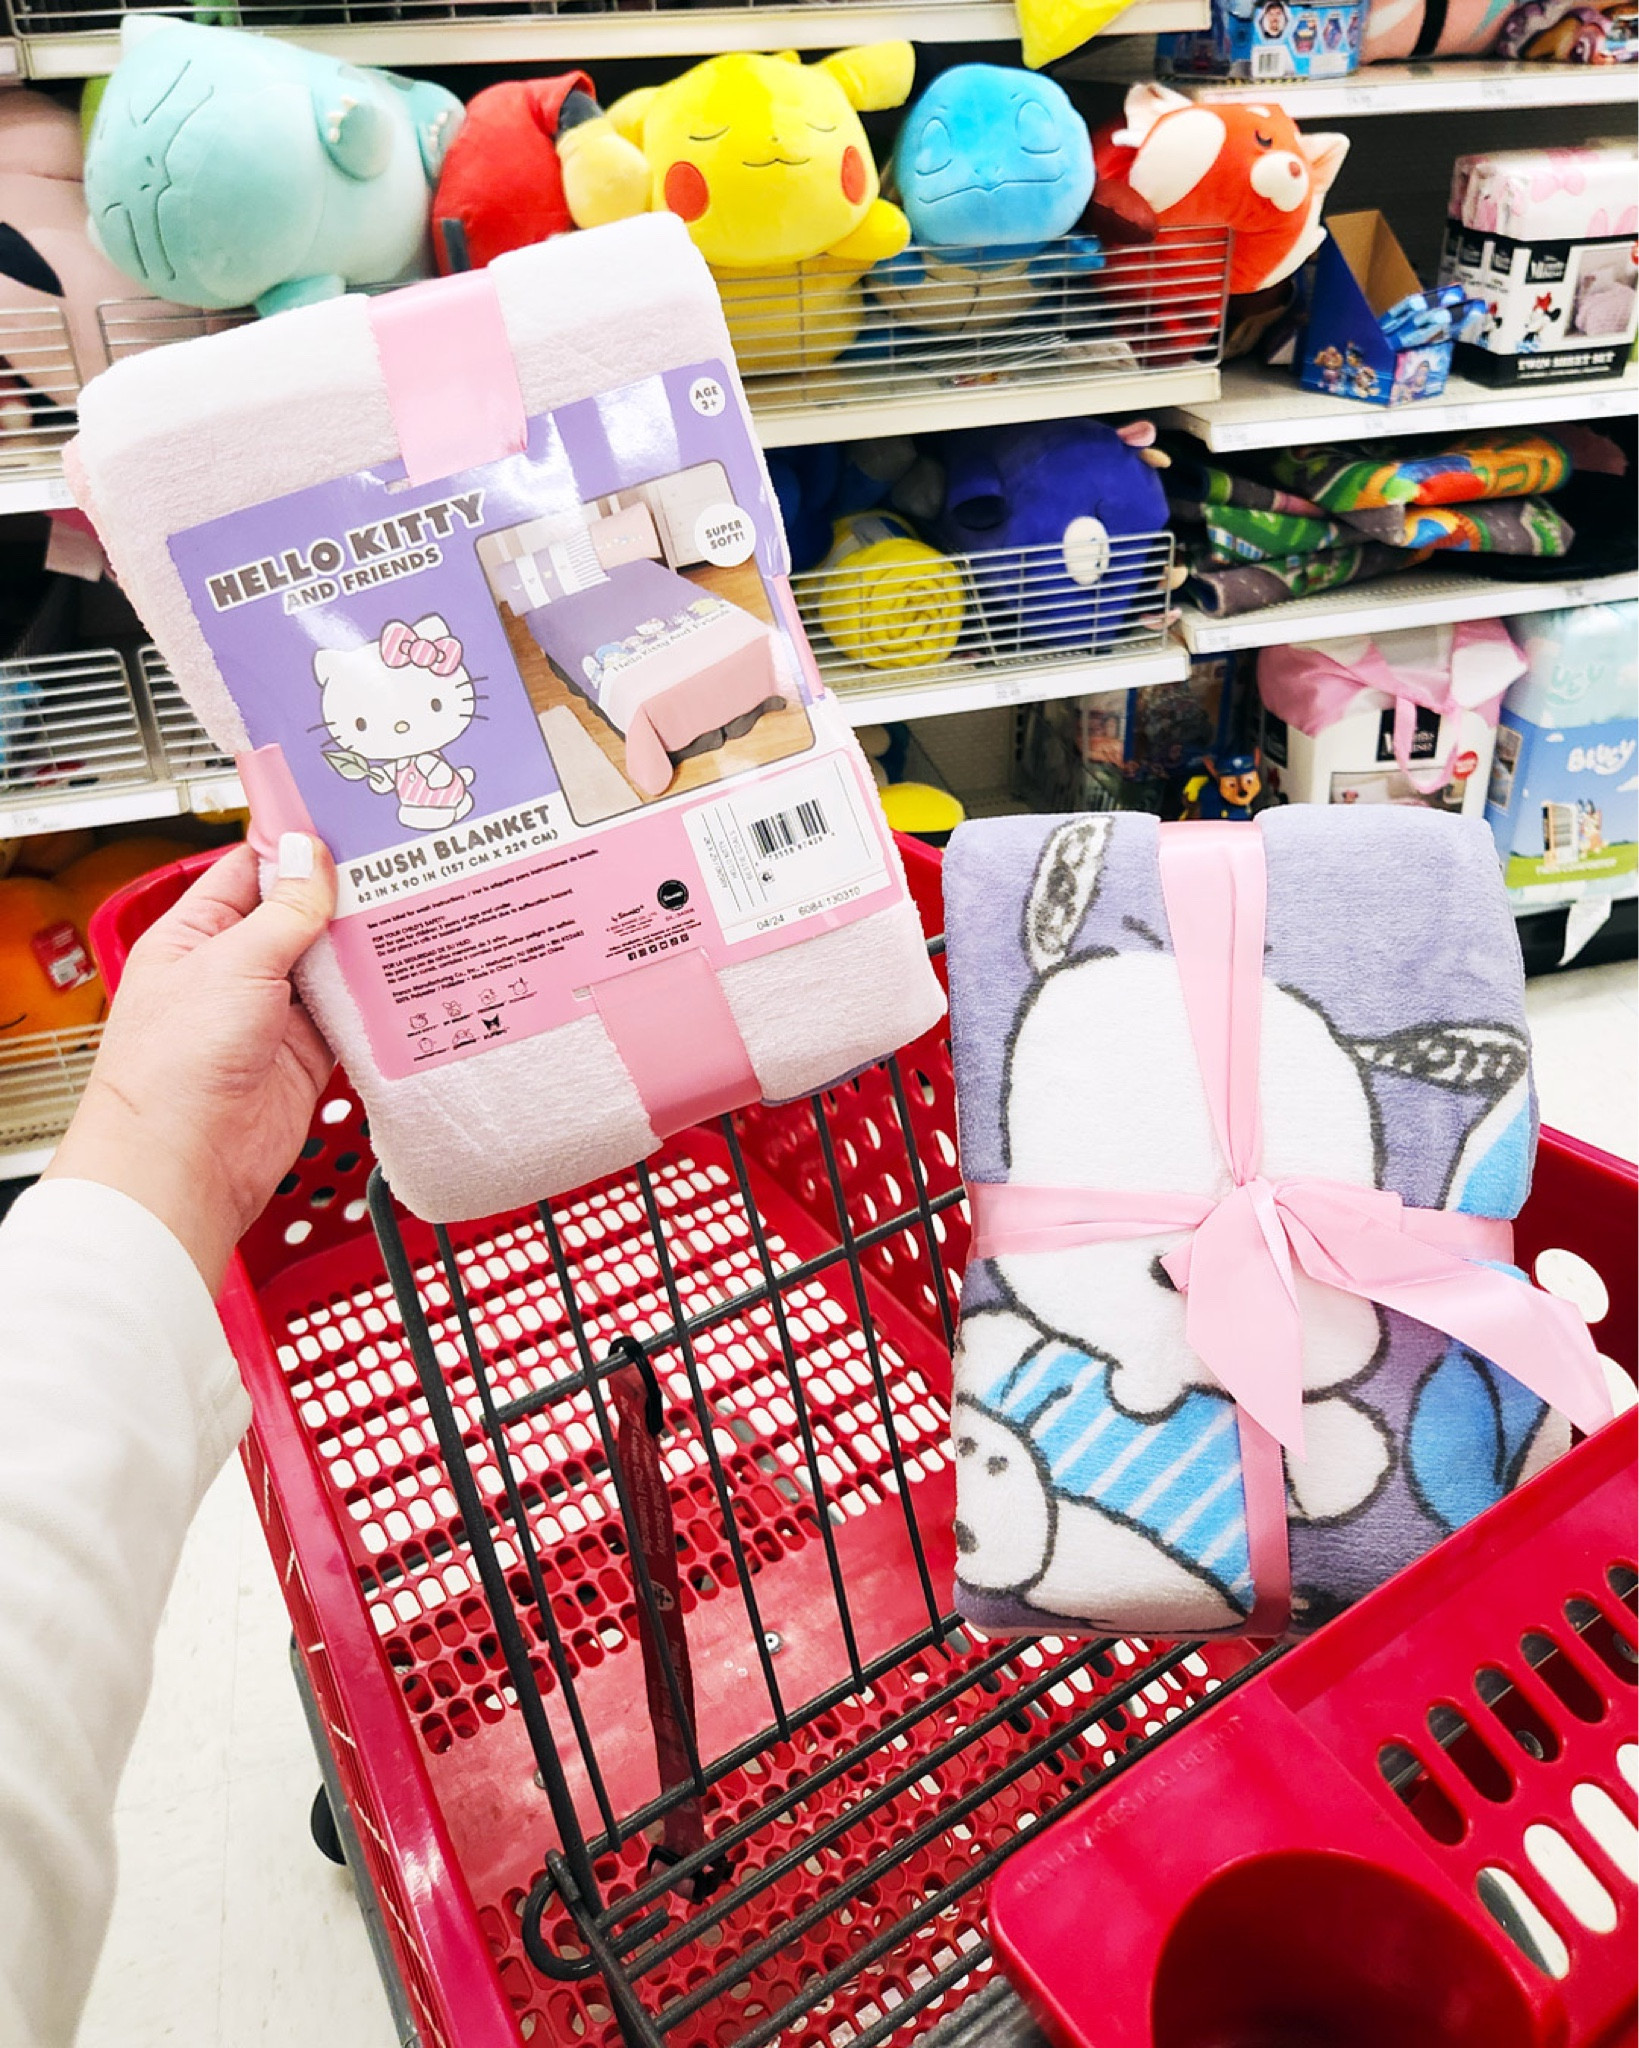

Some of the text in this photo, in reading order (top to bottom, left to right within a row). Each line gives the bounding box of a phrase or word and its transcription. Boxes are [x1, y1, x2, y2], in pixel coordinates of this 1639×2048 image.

[695, 386, 718, 399] AGE
[702, 400, 717, 410] 3+
[207, 489, 489, 610] HELLO KITTY
[705, 520, 742, 539] SUPER
[710, 530, 745, 549] SOFT!
[282, 543, 441, 613] AND FRIENDS
[348, 803, 554, 889] PLUSH BLANKET
[357, 828, 559, 904] 62 IN X 90 IN (157 CM X 229 CM)
